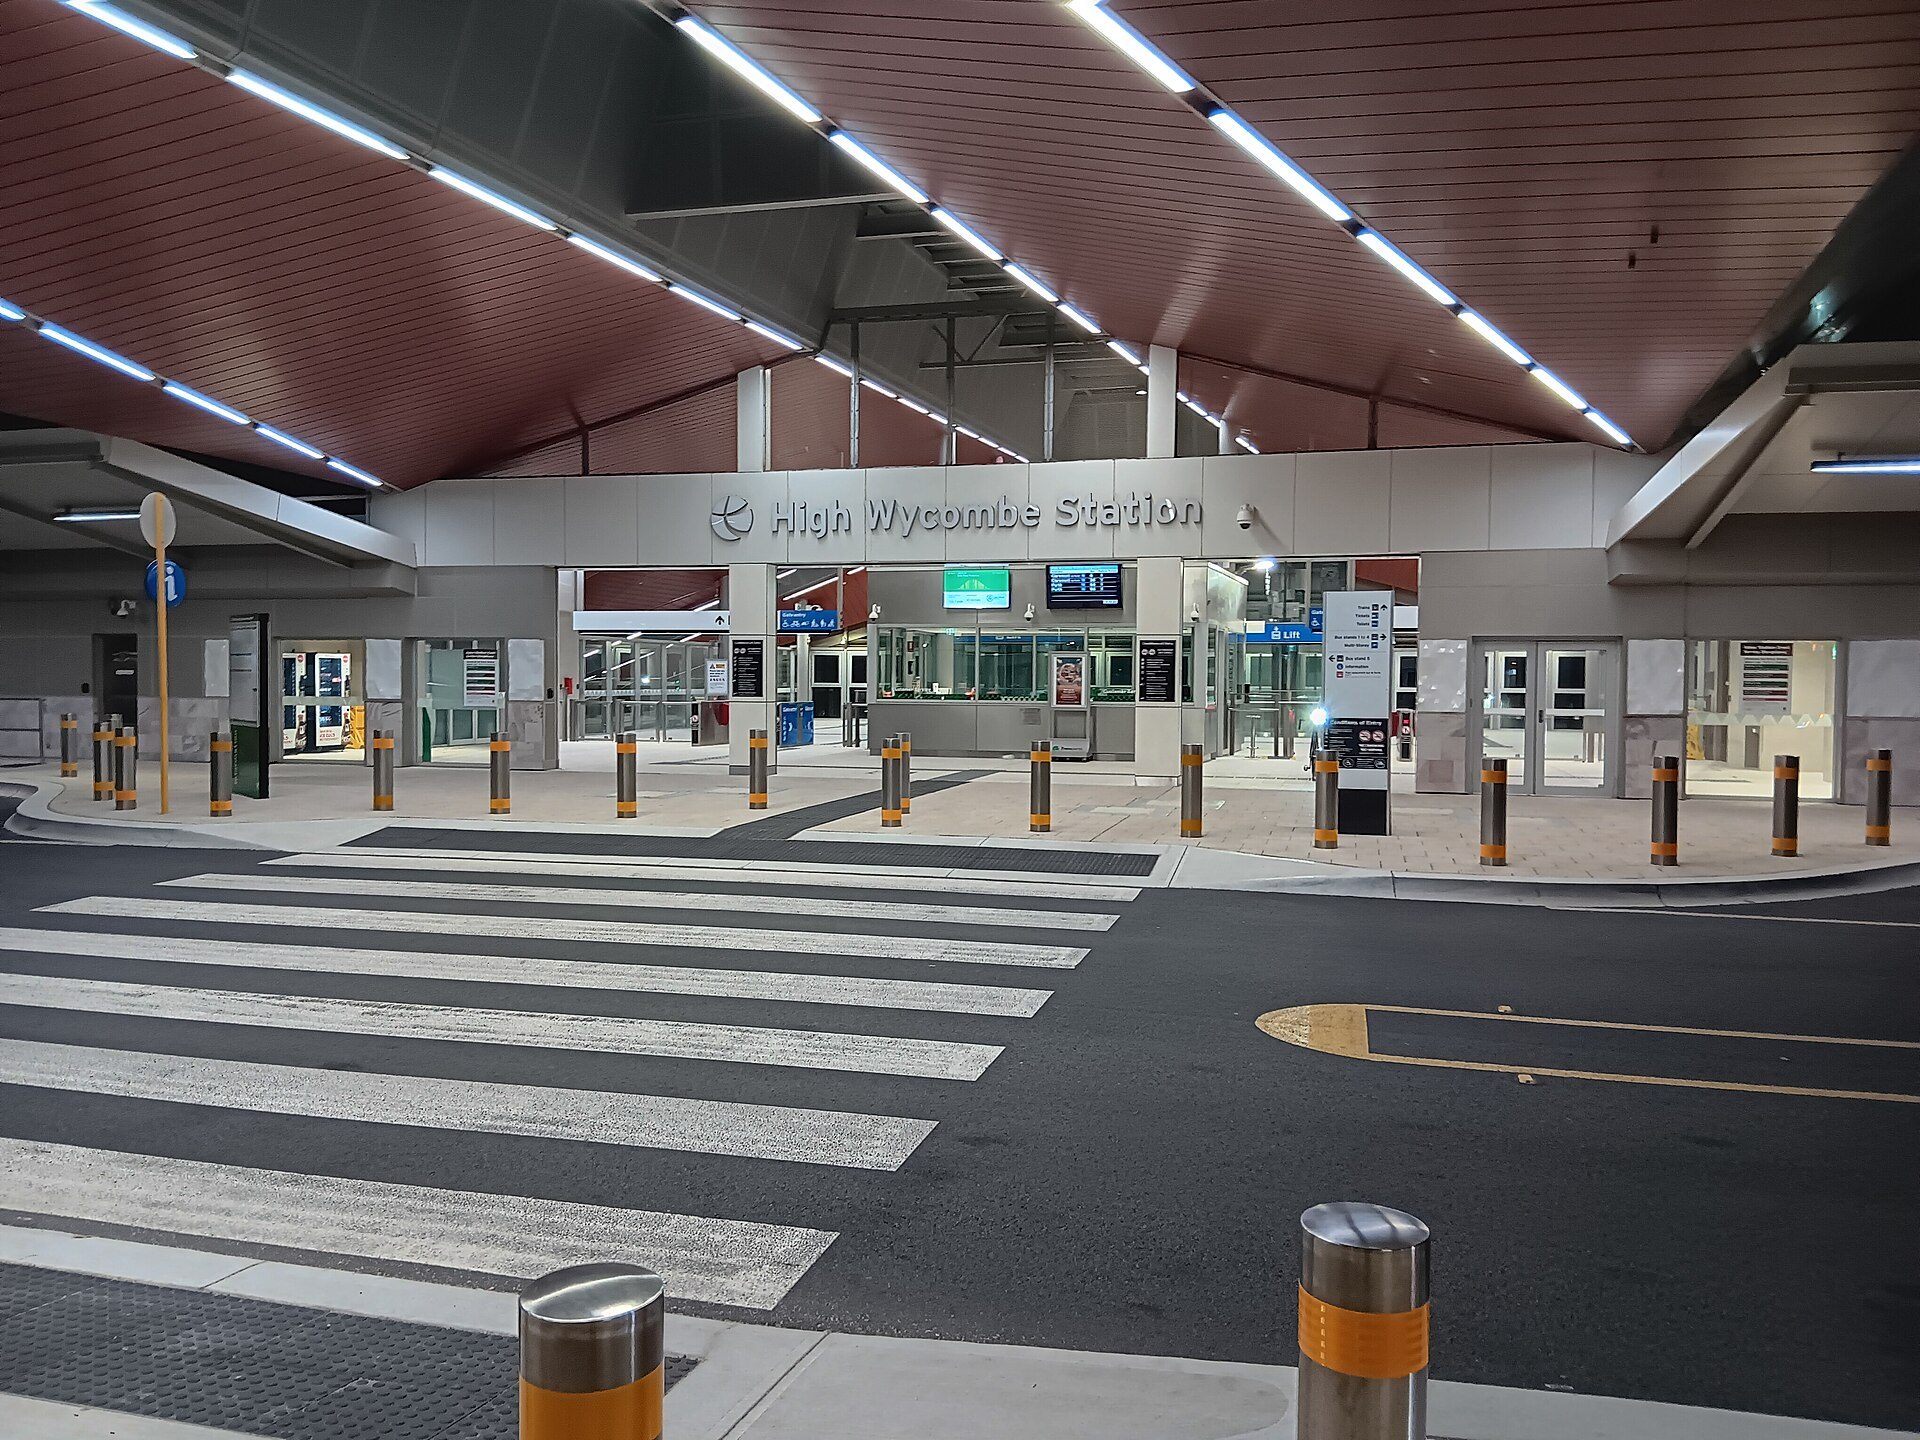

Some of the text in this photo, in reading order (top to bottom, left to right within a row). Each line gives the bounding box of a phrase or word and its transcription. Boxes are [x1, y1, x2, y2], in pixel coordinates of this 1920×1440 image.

[771, 491, 1203, 540] High Wycombe Station
[1283, 631, 1300, 639] Lift
